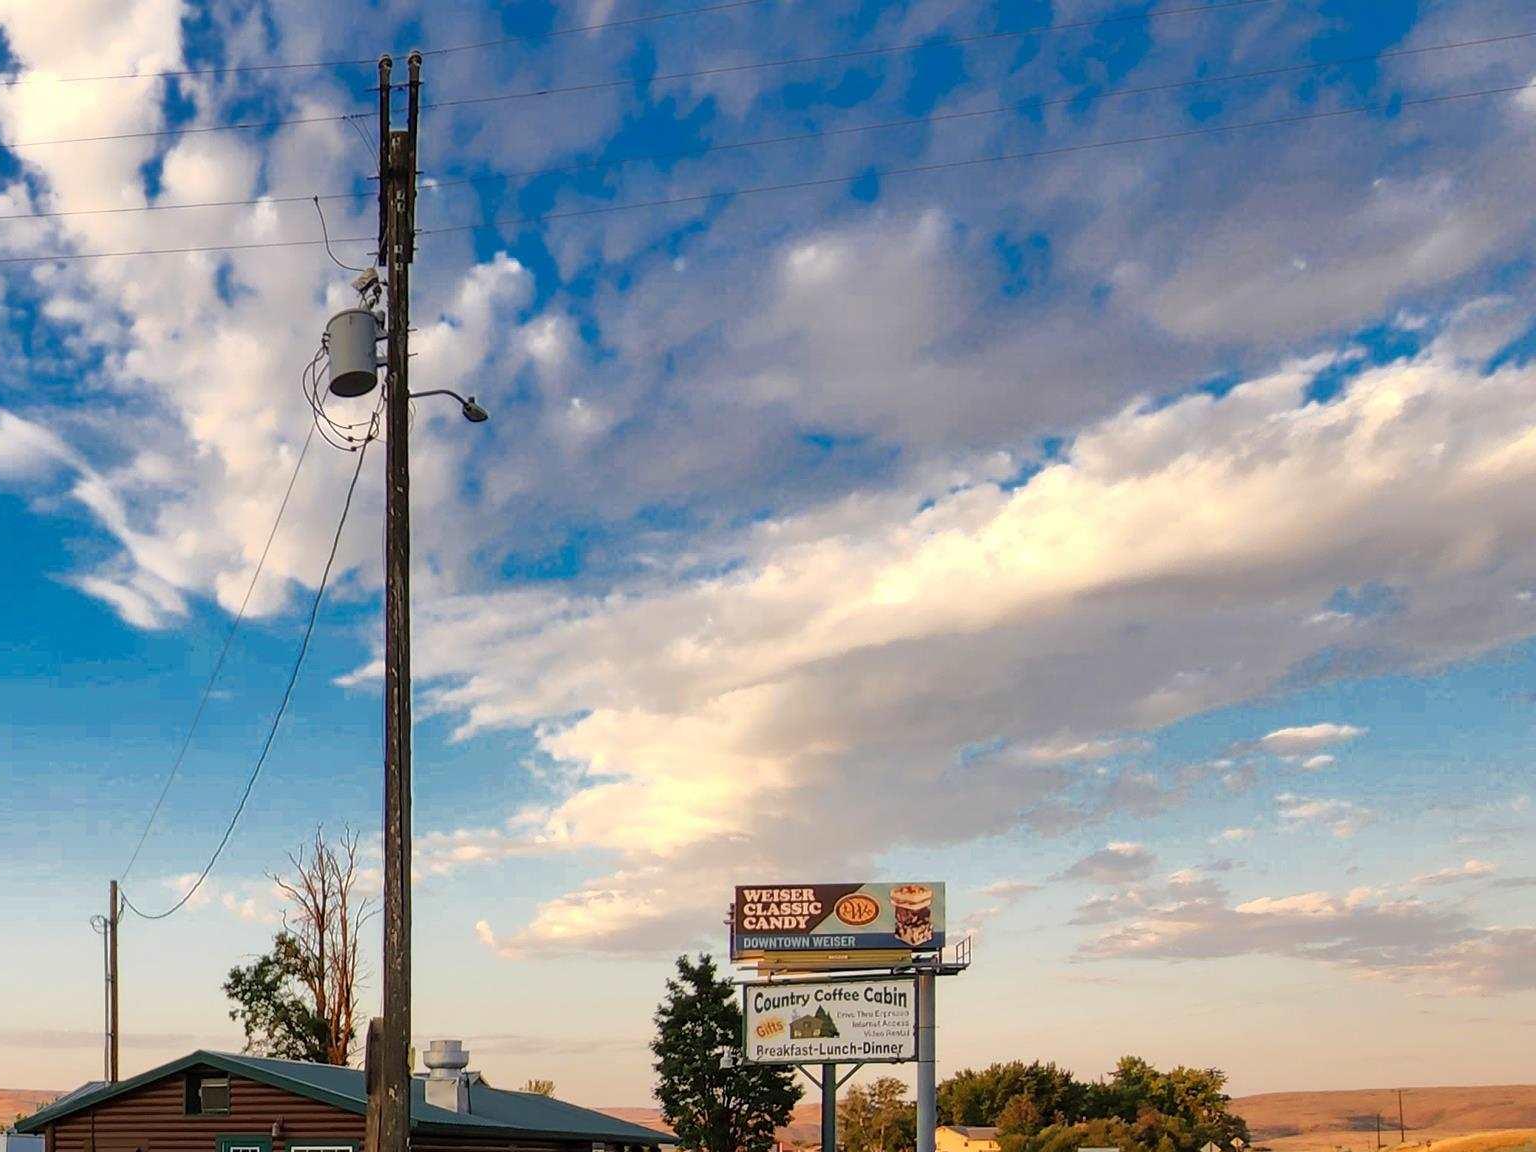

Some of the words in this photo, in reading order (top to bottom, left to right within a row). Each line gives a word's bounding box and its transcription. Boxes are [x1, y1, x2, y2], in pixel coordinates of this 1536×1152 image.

[743, 888, 816, 902] WEISER
[743, 902, 822, 916] CLASSIC
[743, 916, 810, 930] CANDY
[744, 937, 810, 948] DOWNTOWN
[812, 935, 856, 947] WEISER
[754, 992, 810, 1014] Country
[814, 988, 860, 1002] Coffee
[864, 986, 908, 1008] Cabin
[756, 1019, 784, 1038] Gifts
